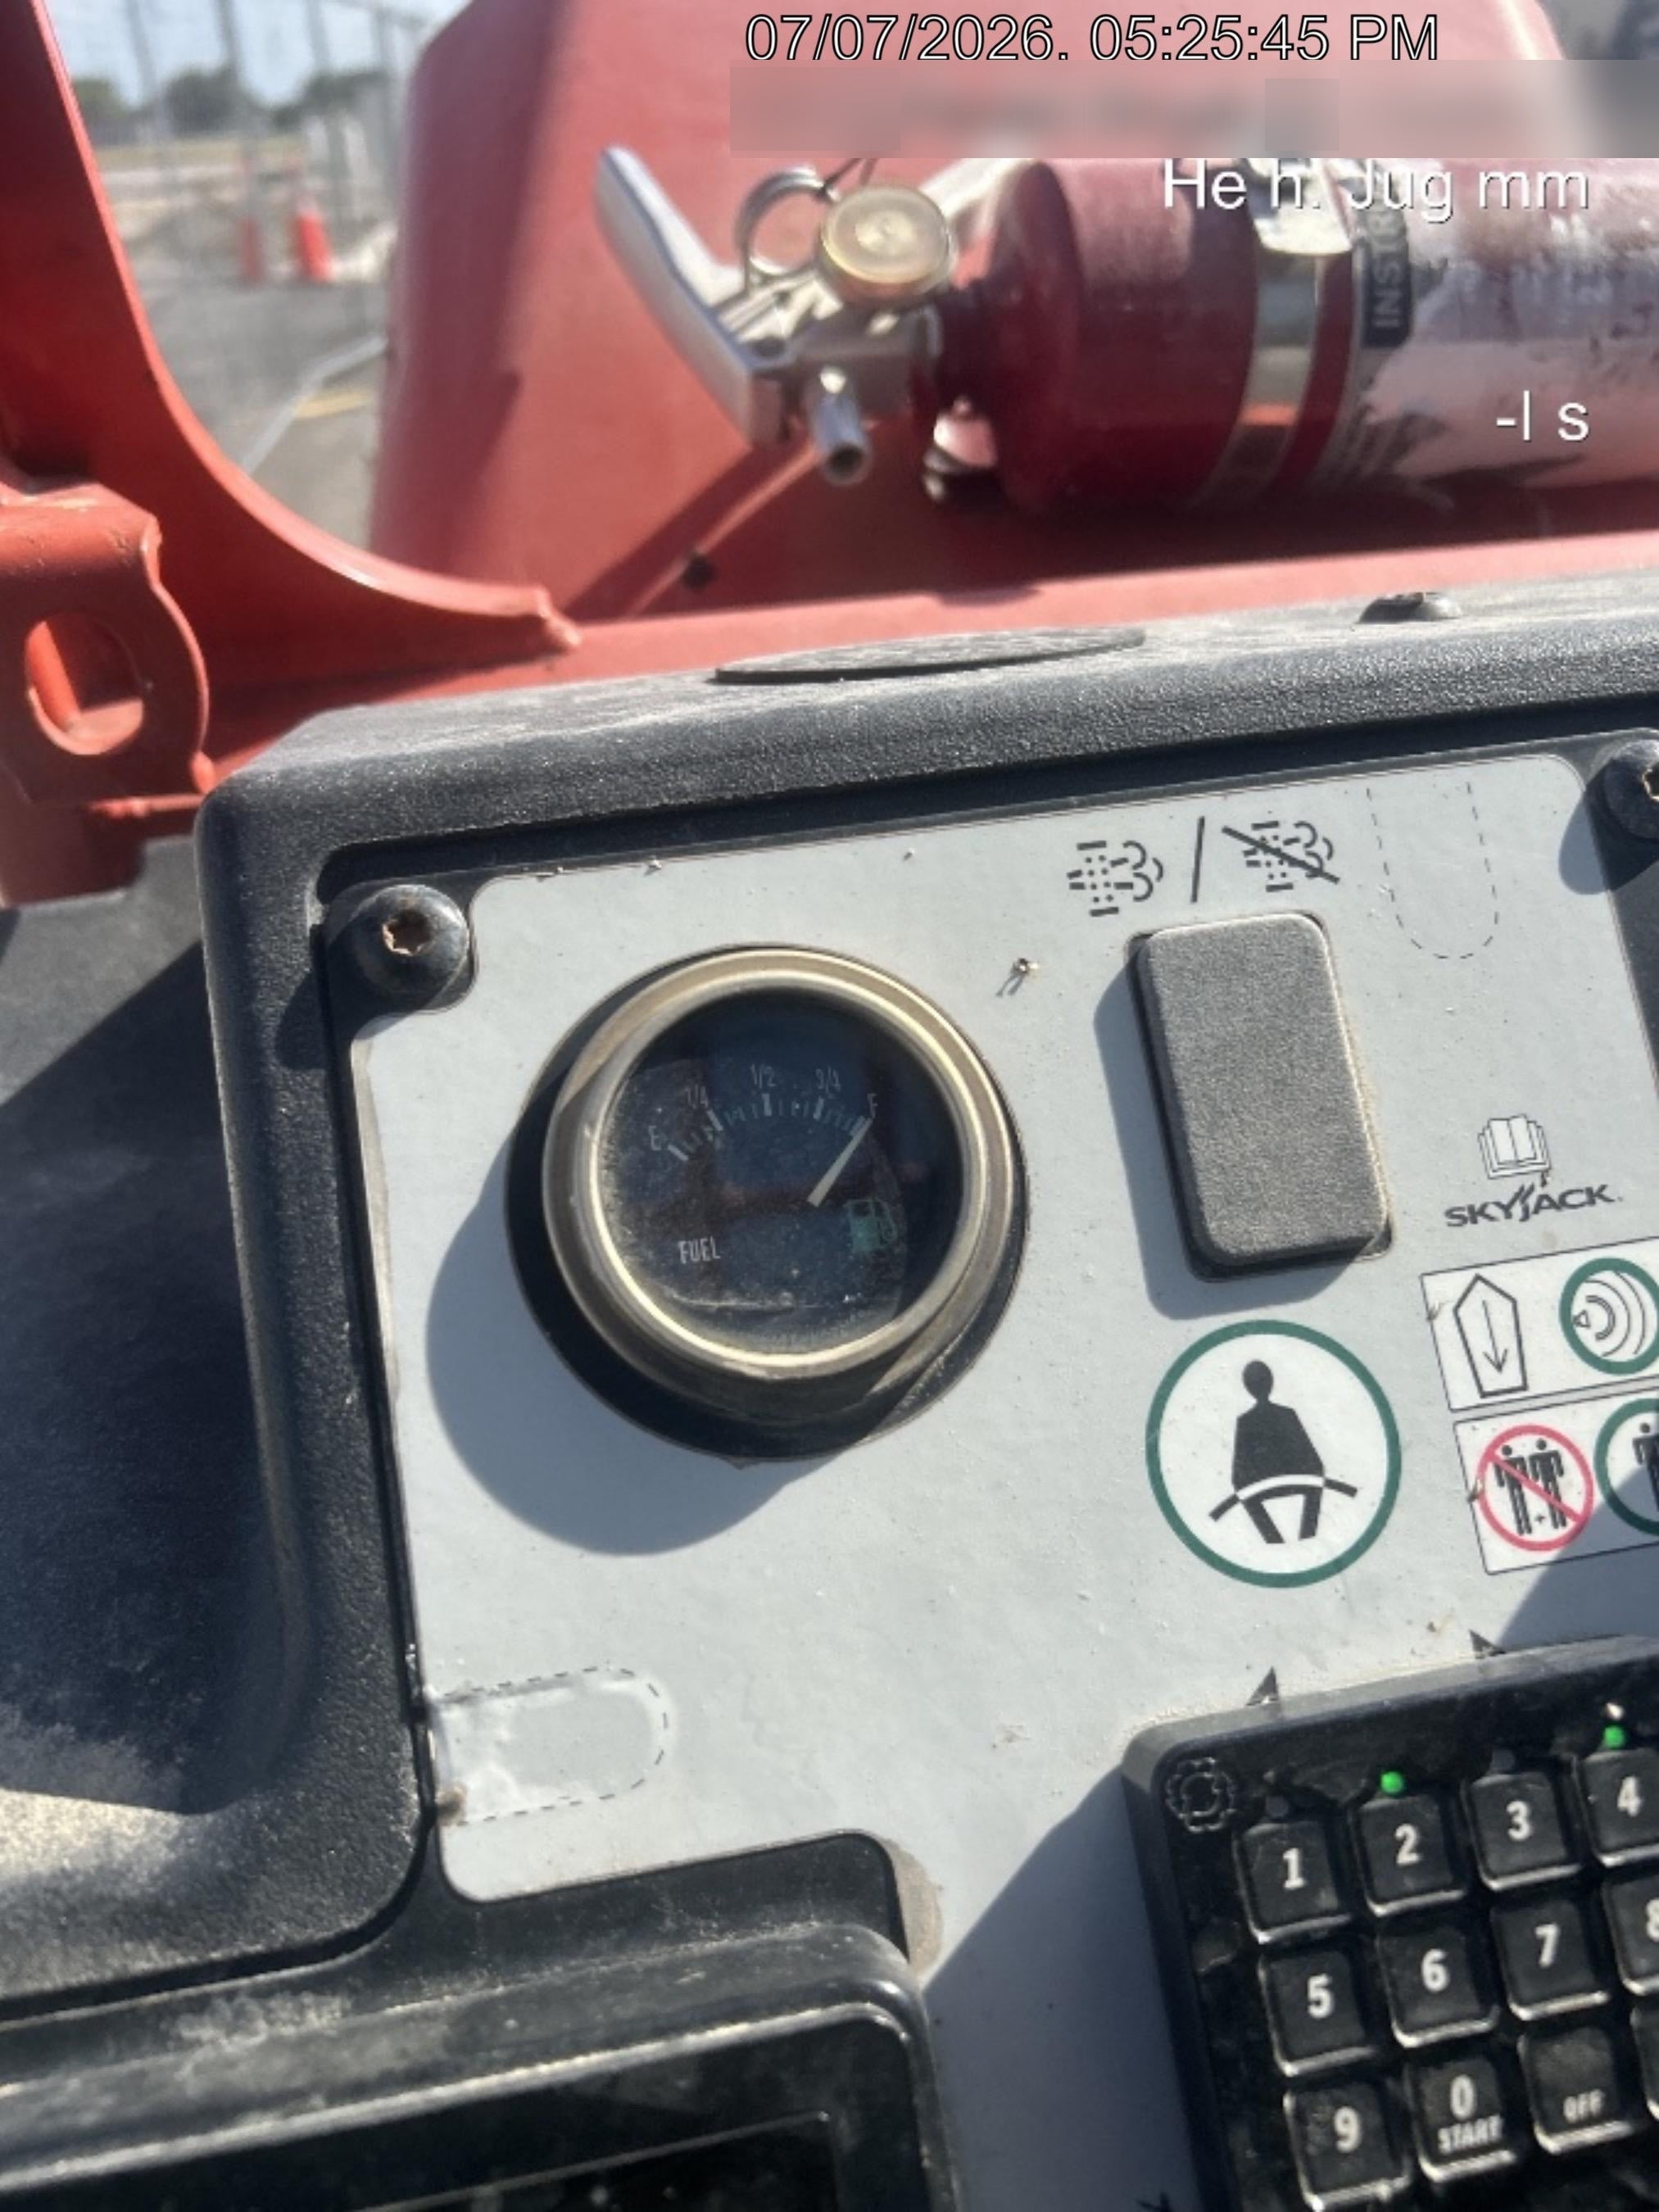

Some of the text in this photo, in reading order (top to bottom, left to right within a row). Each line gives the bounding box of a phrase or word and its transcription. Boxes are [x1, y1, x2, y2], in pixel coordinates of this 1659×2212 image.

[750, 1063, 777, 1090] 1/2
[1444, 1183, 1616, 1227] SKYJACK
[678, 1235, 721, 1264] FUEL
[1616, 1775, 1642, 1817] 4
[1506, 1800, 1533, 1841] 3
[1394, 1824, 1421, 1866] 2
[1281, 1847, 1305, 1890] 1
[1534, 1922, 1562, 1967] 7
[1421, 1948, 1450, 1992] 6
[1307, 1974, 1335, 2019] 5
[1449, 2074, 1475, 2120] 0
[1563, 2088, 1606, 2124] OFF
[1334, 2105, 1362, 2153] 9
[1438, 2114, 1504, 2155] START
